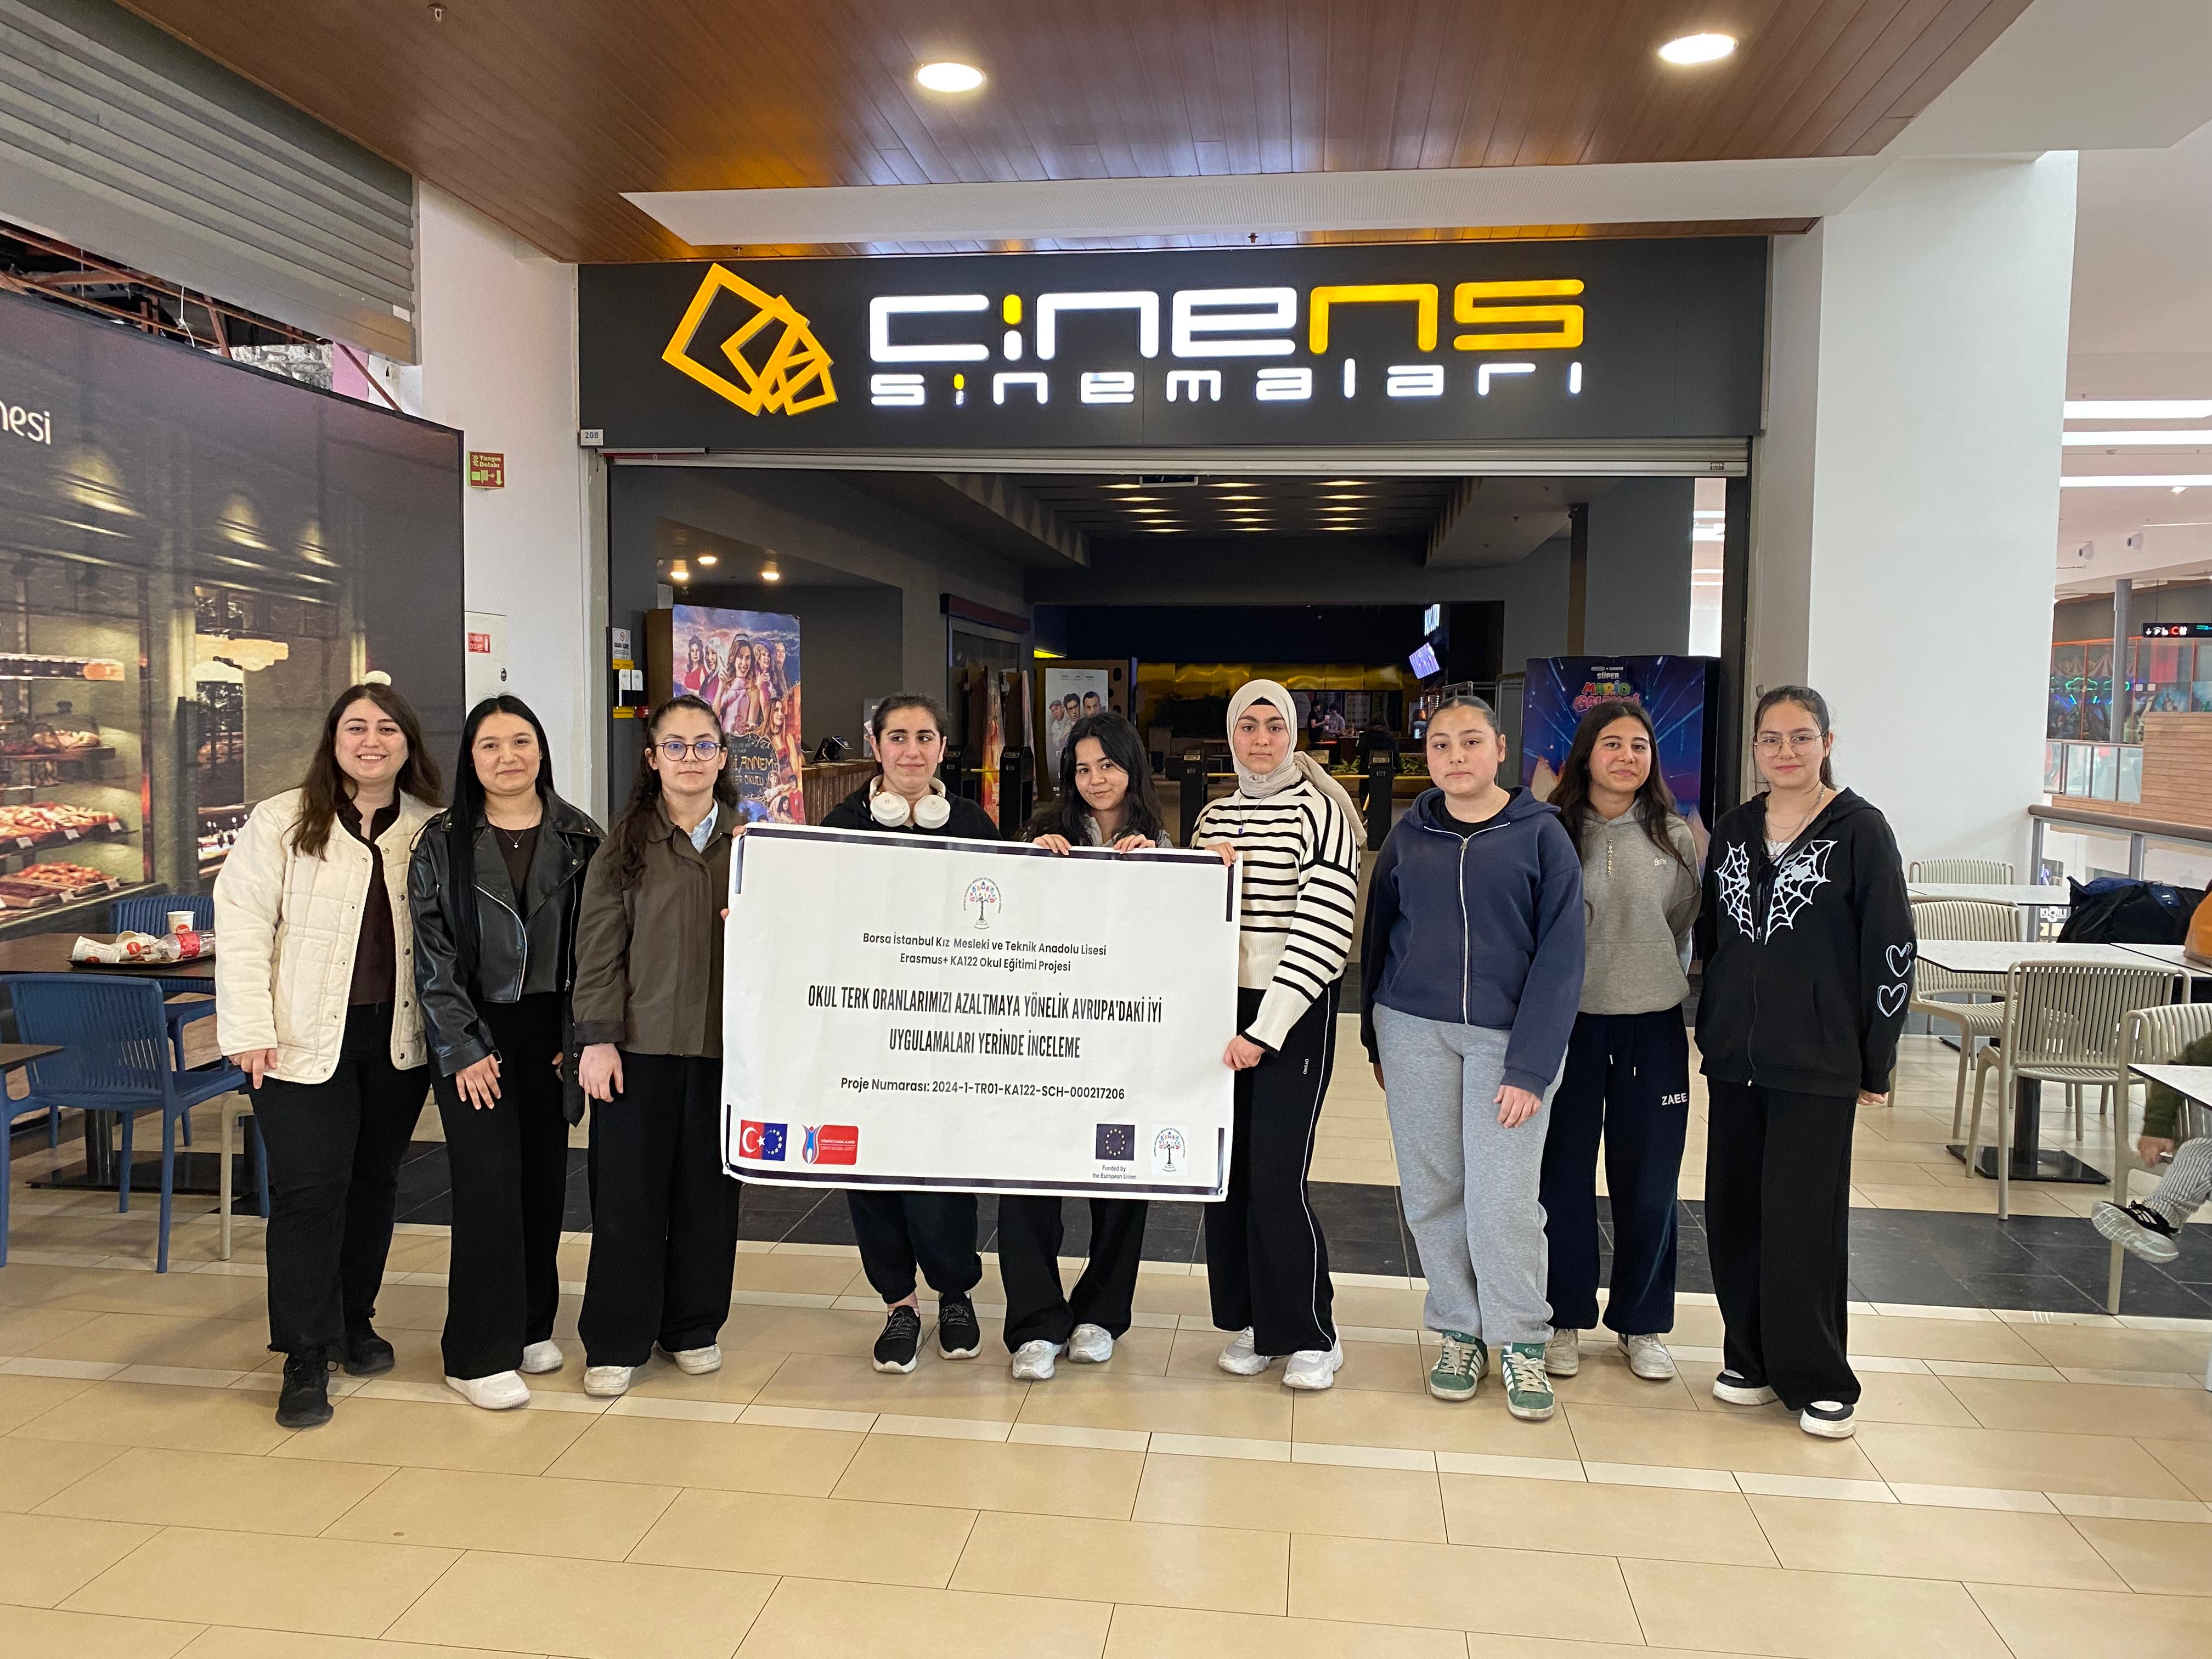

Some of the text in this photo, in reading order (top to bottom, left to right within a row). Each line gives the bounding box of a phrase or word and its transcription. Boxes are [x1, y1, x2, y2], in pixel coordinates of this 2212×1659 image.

[863, 932, 1107, 956] Borsa İstanbul Kız Mesleki ve Teknik Anadolu Lisesi
[900, 953, 1071, 974] Erasmus+ KA122 Okul Eğitimi Projesi
[808, 985, 1162, 1023] OKUL TERK ORANLARIMIZI AZALTMAYA YÖNELİK AVRUPA'DAKİ İYİ
[889, 1028, 1081, 1058] UYGULAMALARI YERİNDE İNCELEME
[841, 1077, 1125, 1099] Proje Numarası: 2024-1-TR01-KA122-SCH-000217206
[1662, 1092, 1688, 1105] ZAEE
